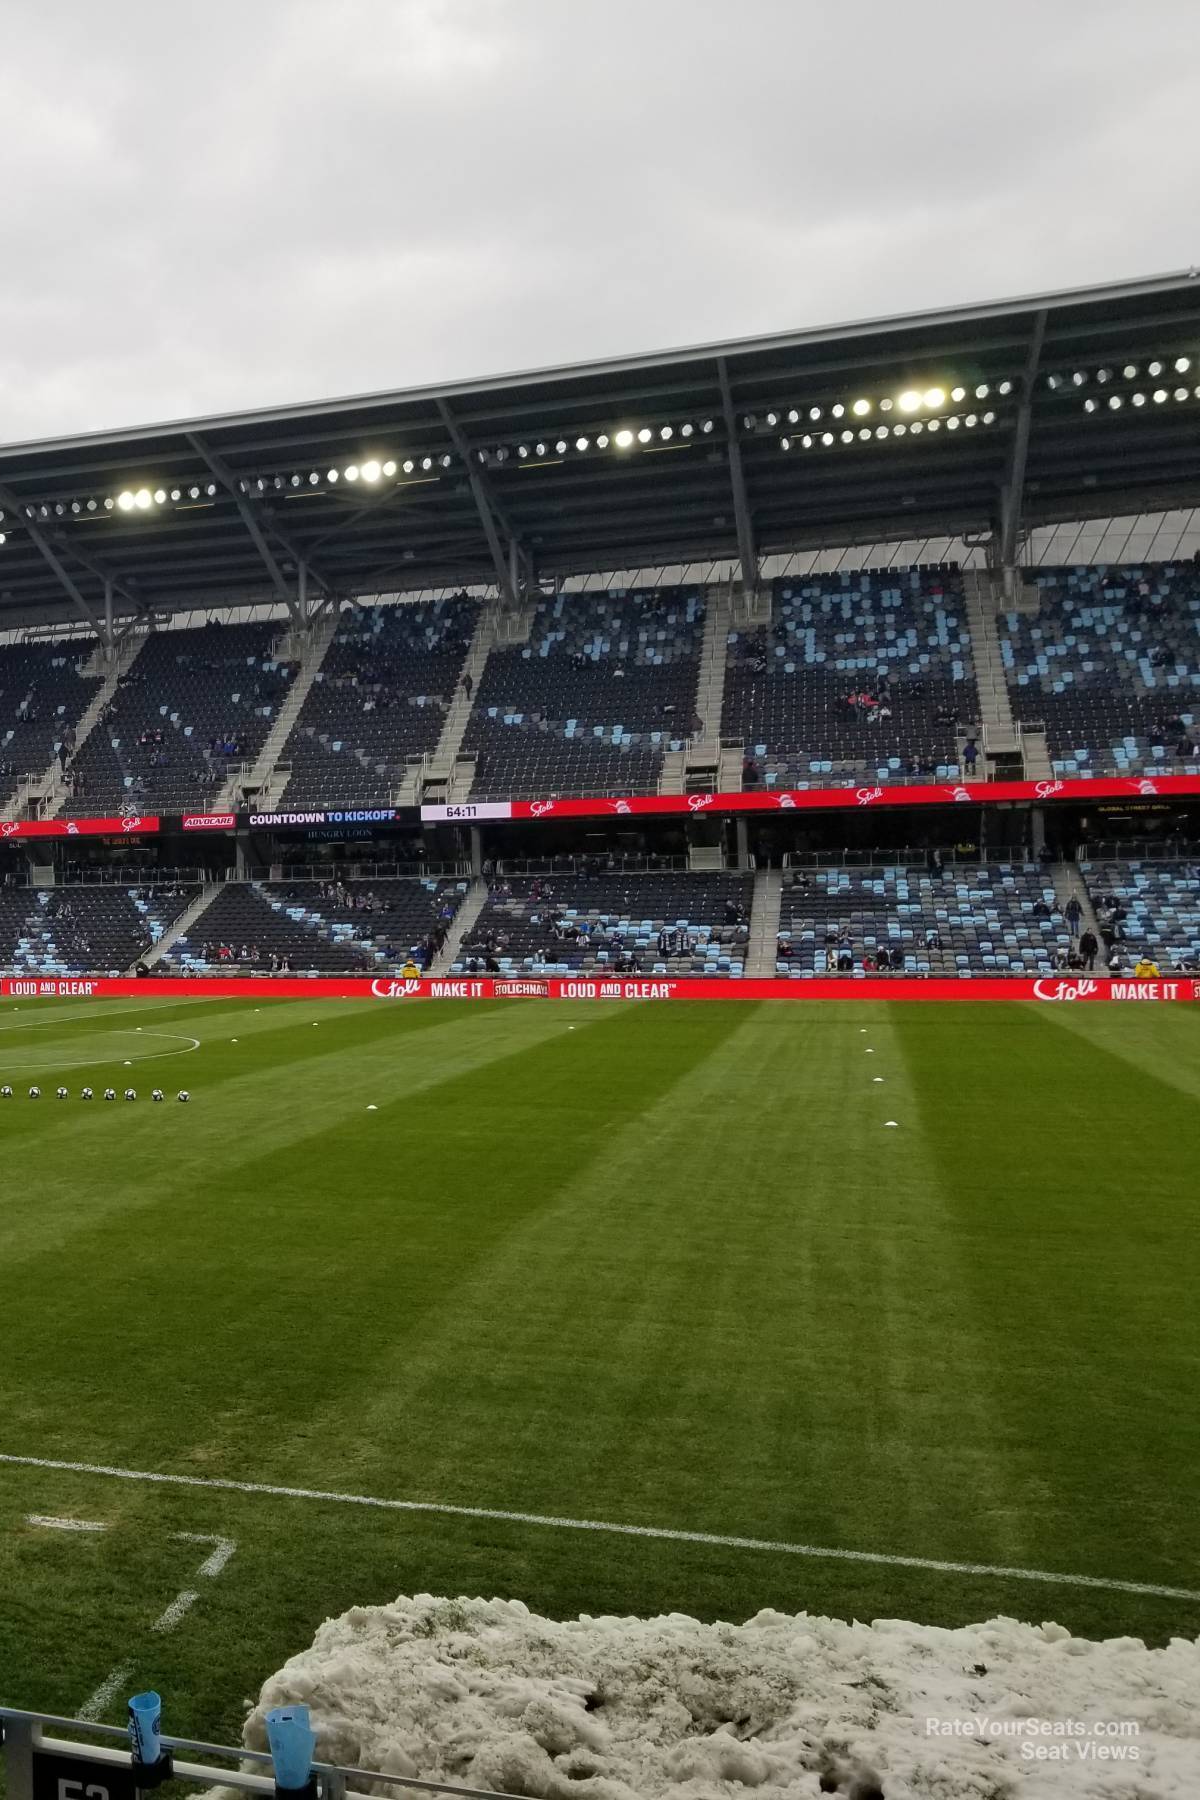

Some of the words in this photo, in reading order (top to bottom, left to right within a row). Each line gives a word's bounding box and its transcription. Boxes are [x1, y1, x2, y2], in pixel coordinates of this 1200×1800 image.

[856, 788, 884, 805] Stoli
[1035, 781, 1064, 798] Stoli
[530, 801, 554, 817] Stoli
[688, 795, 714, 811] Stoli
[250, 812, 325, 825] COUNTDOWN
[327, 812, 342, 822] TO
[446, 806, 477, 817] 64:11
[1, 822, 20, 836] Stoli
[122, 817, 142, 832] Stoli
[184, 817, 233, 827] ADVOCARE
[10, 982, 37, 995] LOUD
[40, 982, 56, 992] AND
[431, 982, 468, 997] MAKE
[471, 982, 483, 997] IT
[560, 983, 596, 998] LOUD
[600, 983, 621, 995] AND
[1110, 983, 1158, 1000] MAKE
[1163, 983, 1179, 1000] IT
